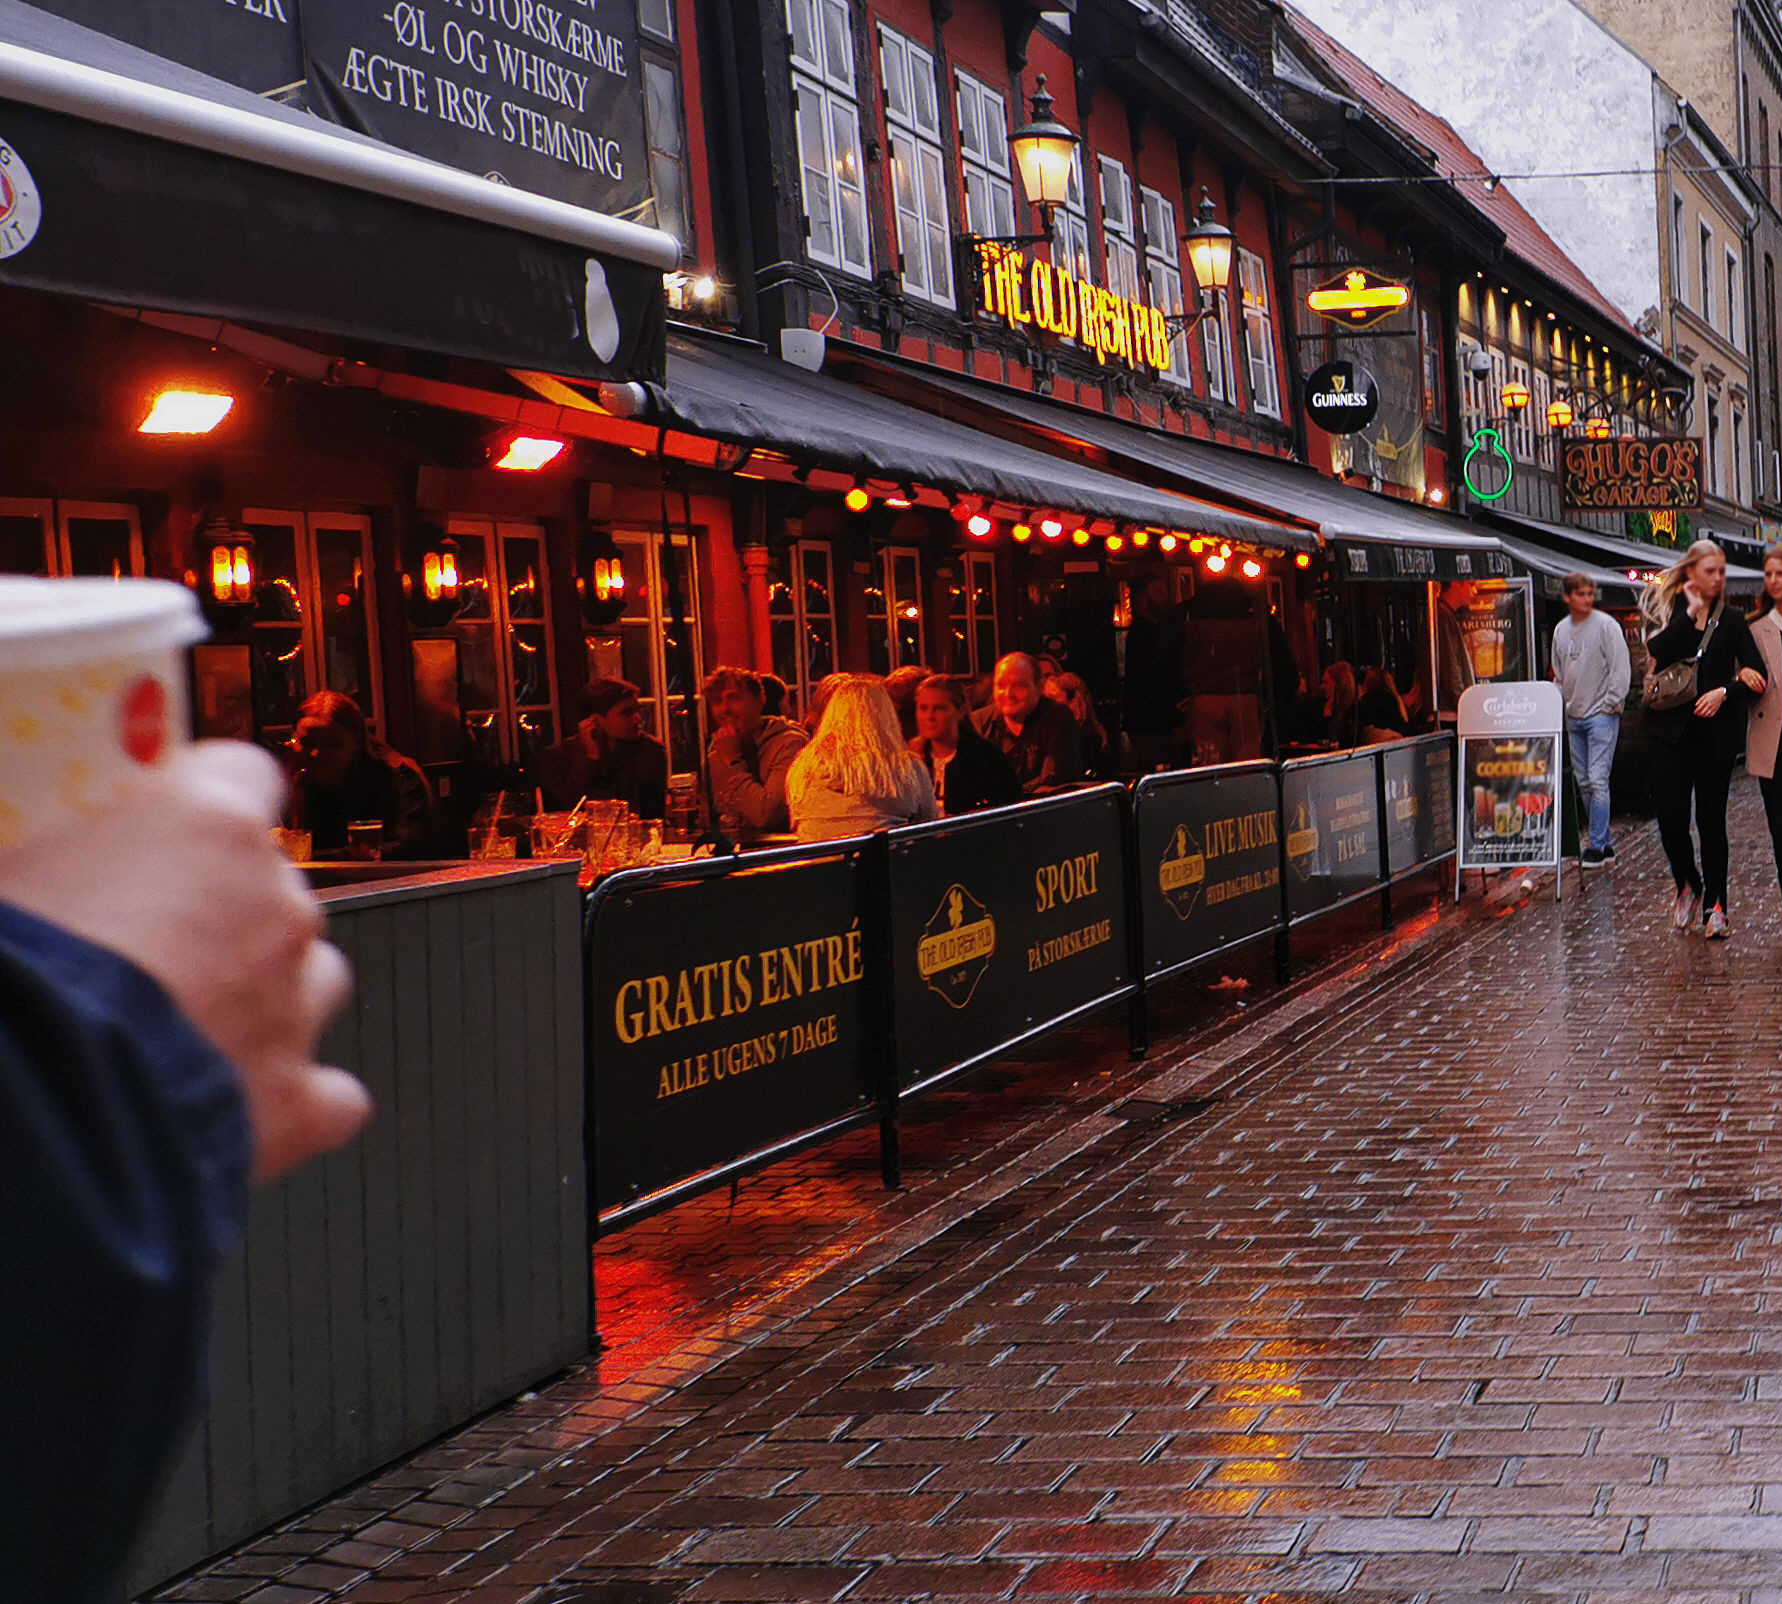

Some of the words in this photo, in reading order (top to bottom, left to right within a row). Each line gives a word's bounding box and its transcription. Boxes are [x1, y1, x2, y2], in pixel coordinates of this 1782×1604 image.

[444, 21, 488, 75] OG
[493, 39, 589, 113] WHISKY
[343, 47, 429, 114] ÆGTE
[435, 77, 496, 136] IRSK
[502, 101, 623, 181] STEMNING
[974, 241, 1031, 330] THE
[1031, 259, 1077, 338] OLD
[1079, 279, 1135, 370] IRISH
[1131, 301, 1170, 370] PUB
[1567, 440, 1698, 486] HUGO'S
[1593, 484, 1673, 507] GARAGE
[1483, 697, 1537, 717] Carlsberg
[1476, 760, 1547, 778] COCKTAILS
[1204, 818, 1235, 860] LIVE
[1237, 810, 1278, 851] MUSIK
[1036, 852, 1100, 913] SPORT
[615, 955, 753, 1045] GRATIS
[759, 916, 865, 1007] ENTRÉ
[656, 1053, 709, 1100] ALLE
[712, 1033, 776, 1081] UGENS
[778, 1030, 788, 1060] 7
[792, 1014, 838, 1056] DAGE
